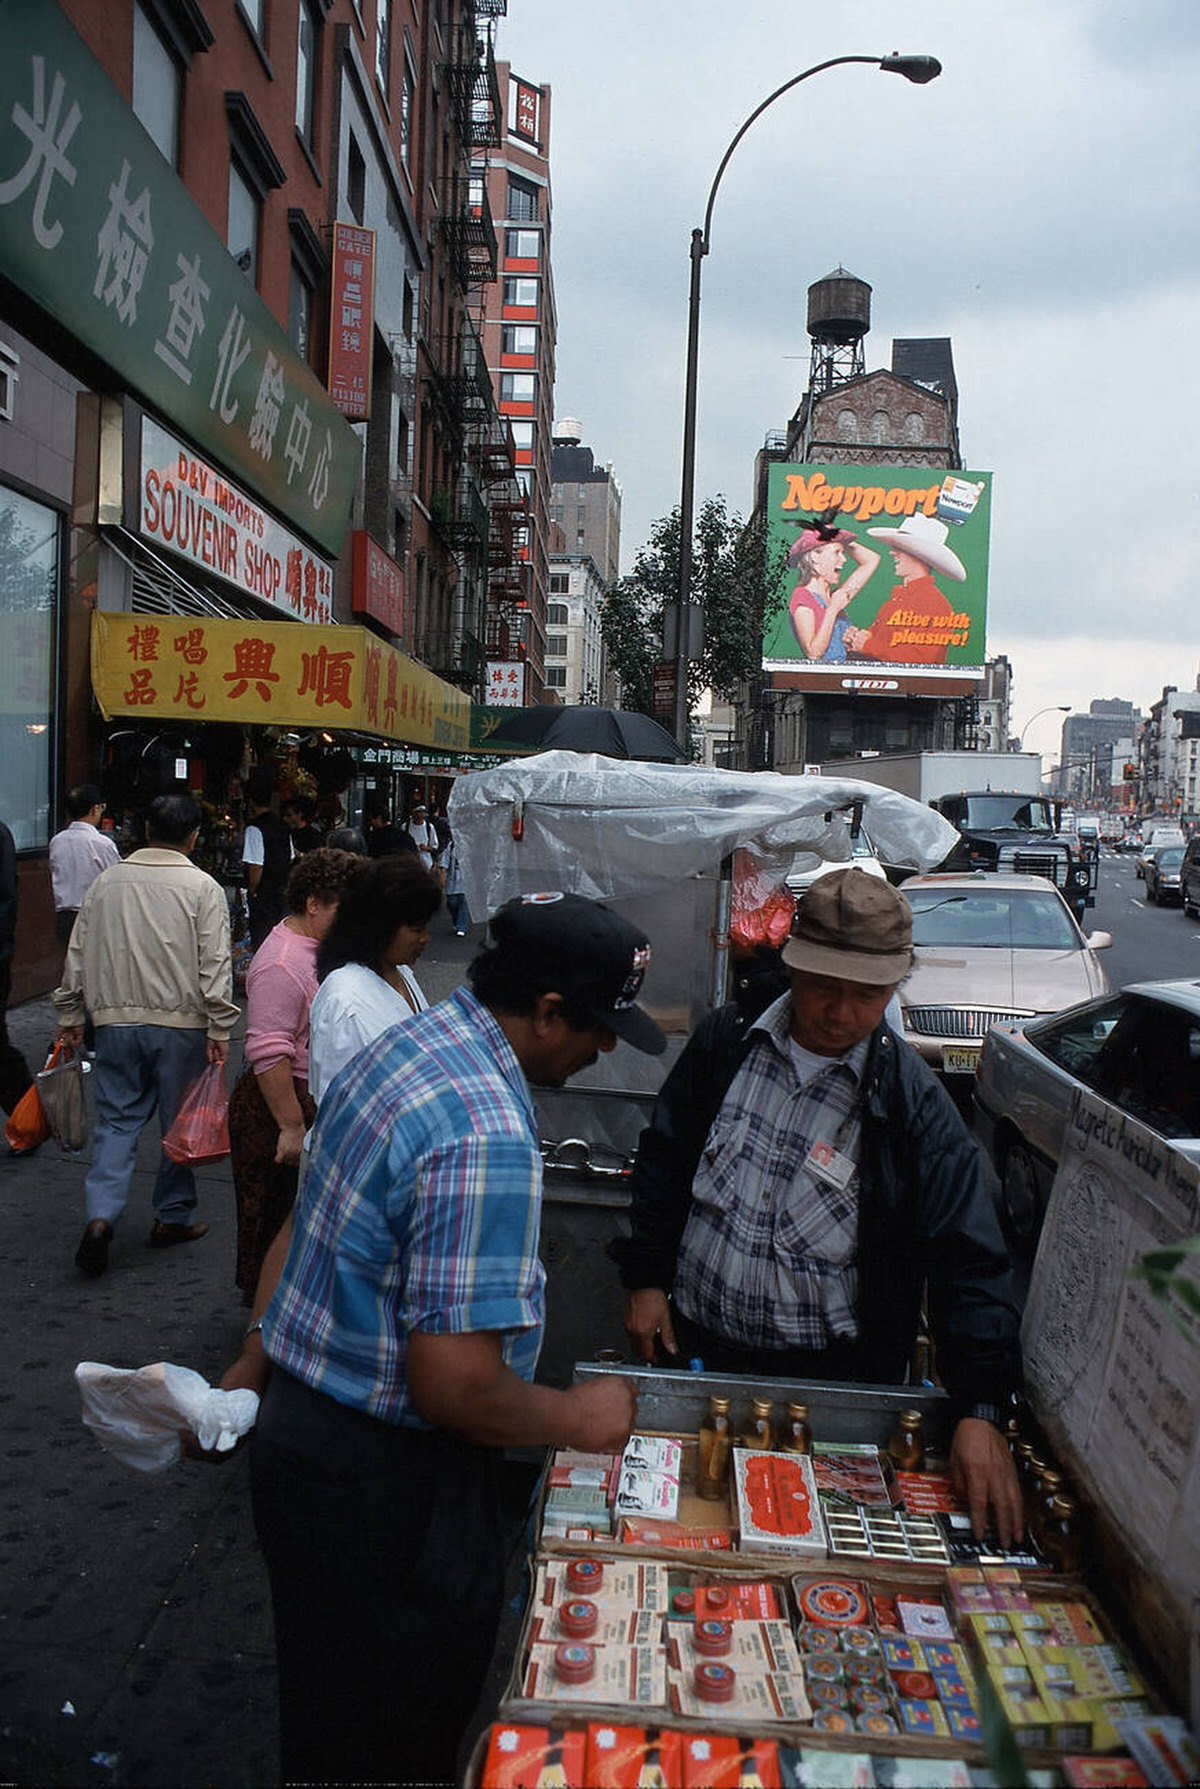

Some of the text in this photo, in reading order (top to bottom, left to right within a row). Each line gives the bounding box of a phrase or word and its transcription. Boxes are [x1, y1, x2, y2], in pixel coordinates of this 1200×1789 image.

[338, 240, 371, 256] GATE
[178, 451, 264, 539] D&V IMPORTS
[781, 473, 941, 521] Newport
[144, 468, 238, 579] SOUVENIR
[244, 538, 281, 601] SHOP
[886, 610, 970, 629] Alive with
[890, 629, 969, 648] pleasure!
[1070, 1086, 1114, 1151] Magnetic
